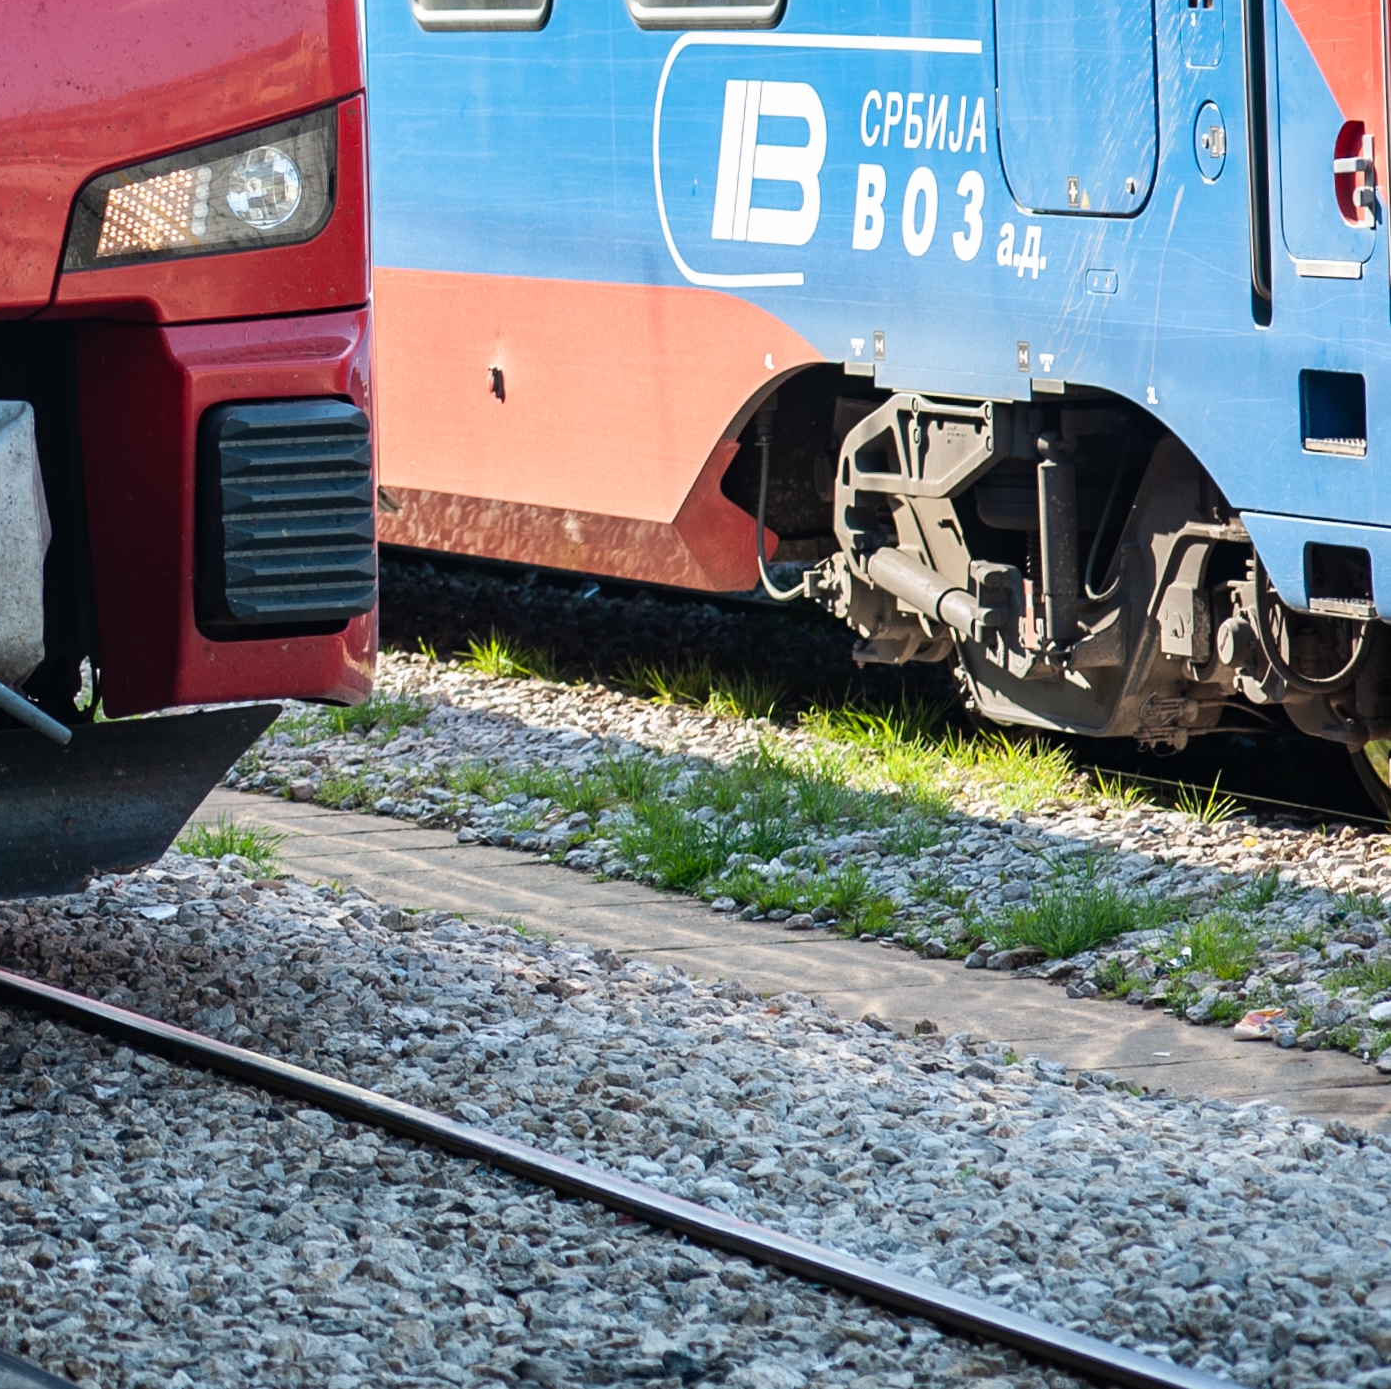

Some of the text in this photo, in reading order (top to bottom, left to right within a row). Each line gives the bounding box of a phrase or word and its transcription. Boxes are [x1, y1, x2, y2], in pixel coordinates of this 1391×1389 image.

[860, 89, 987, 154] СРБИЈА
[852, 163, 1047, 280] ВОЗ а.д.
